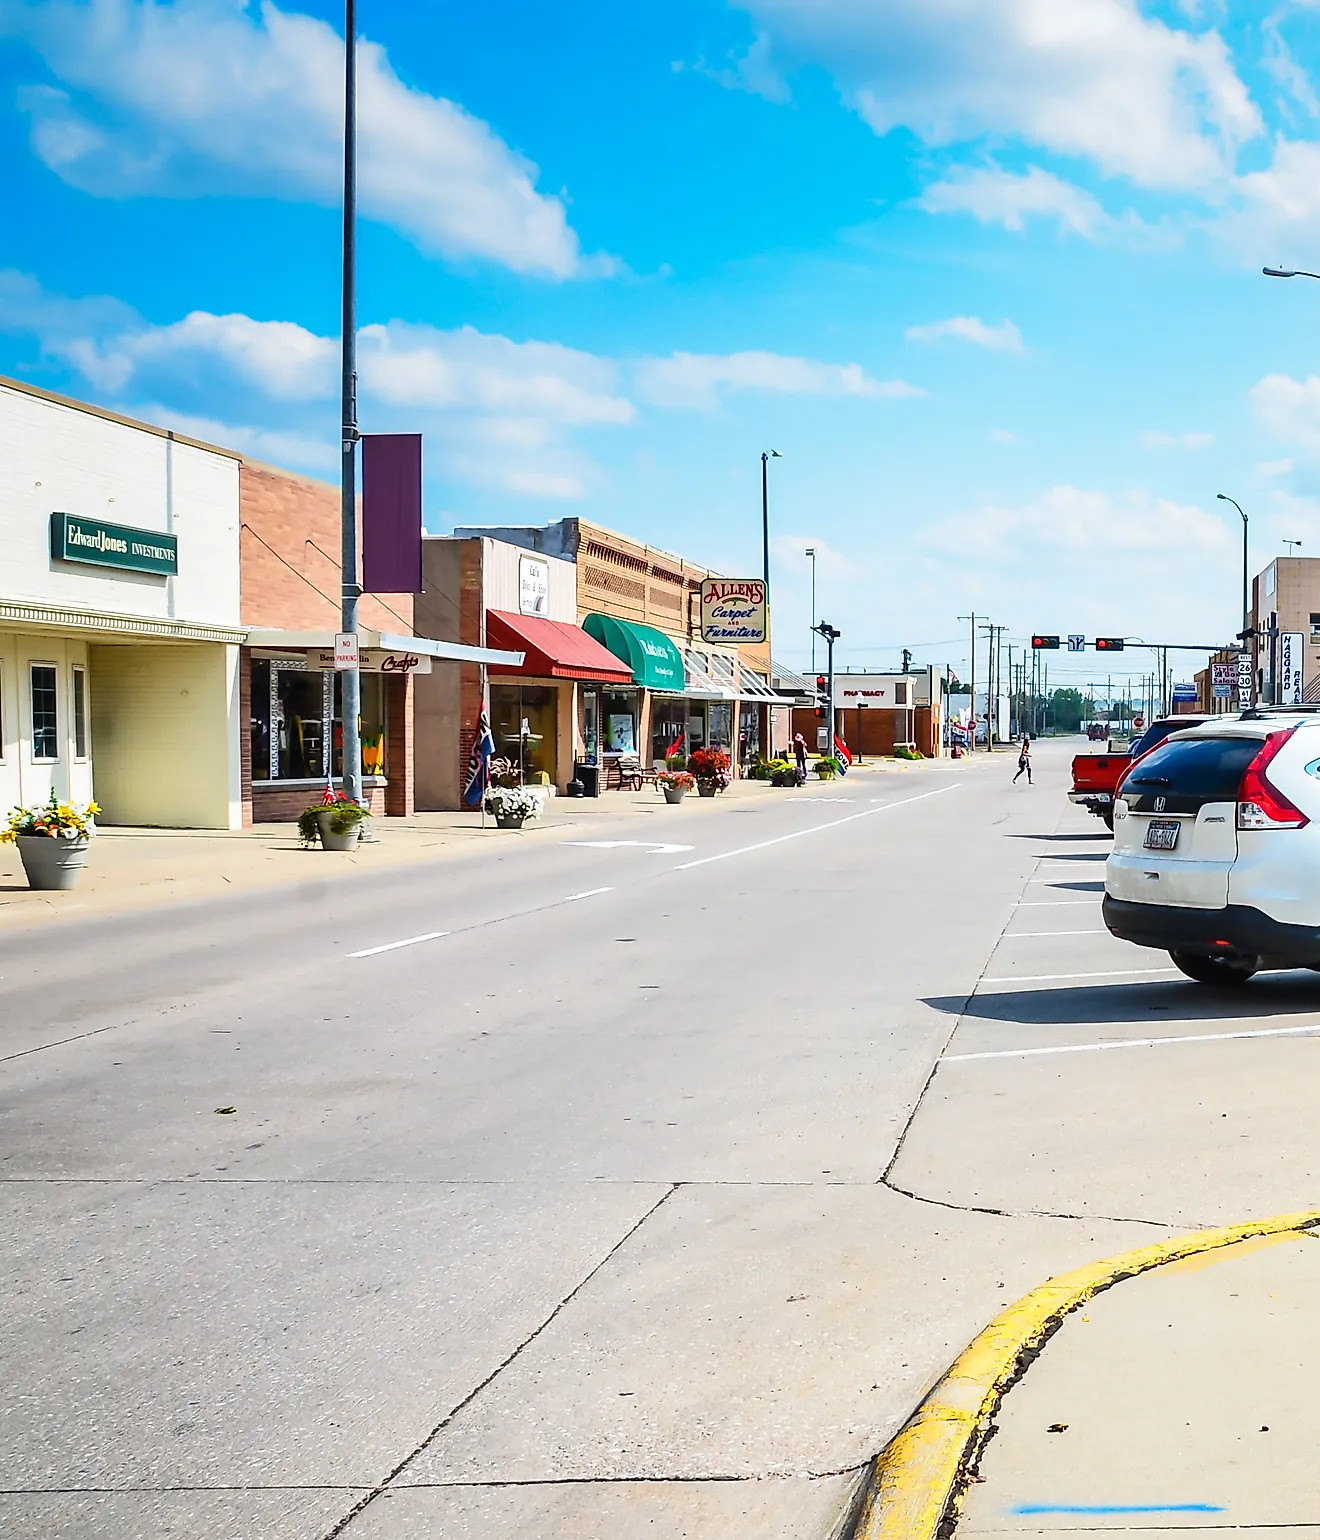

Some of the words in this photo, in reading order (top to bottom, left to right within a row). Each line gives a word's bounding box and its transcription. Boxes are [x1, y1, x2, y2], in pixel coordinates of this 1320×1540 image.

[131, 542, 176, 561] INVESTMENTS
[703, 583, 763, 605] ALLEN'S
[711, 606, 758, 621] Carpet
[704, 625, 763, 638] Furniture
[342, 640, 351, 648] NO
[336, 654, 357, 662] PARKING
[1284, 635, 1292, 690] HAGGARD
[1239, 664, 1251, 672] 26
[1239, 677, 1251, 685] 30
